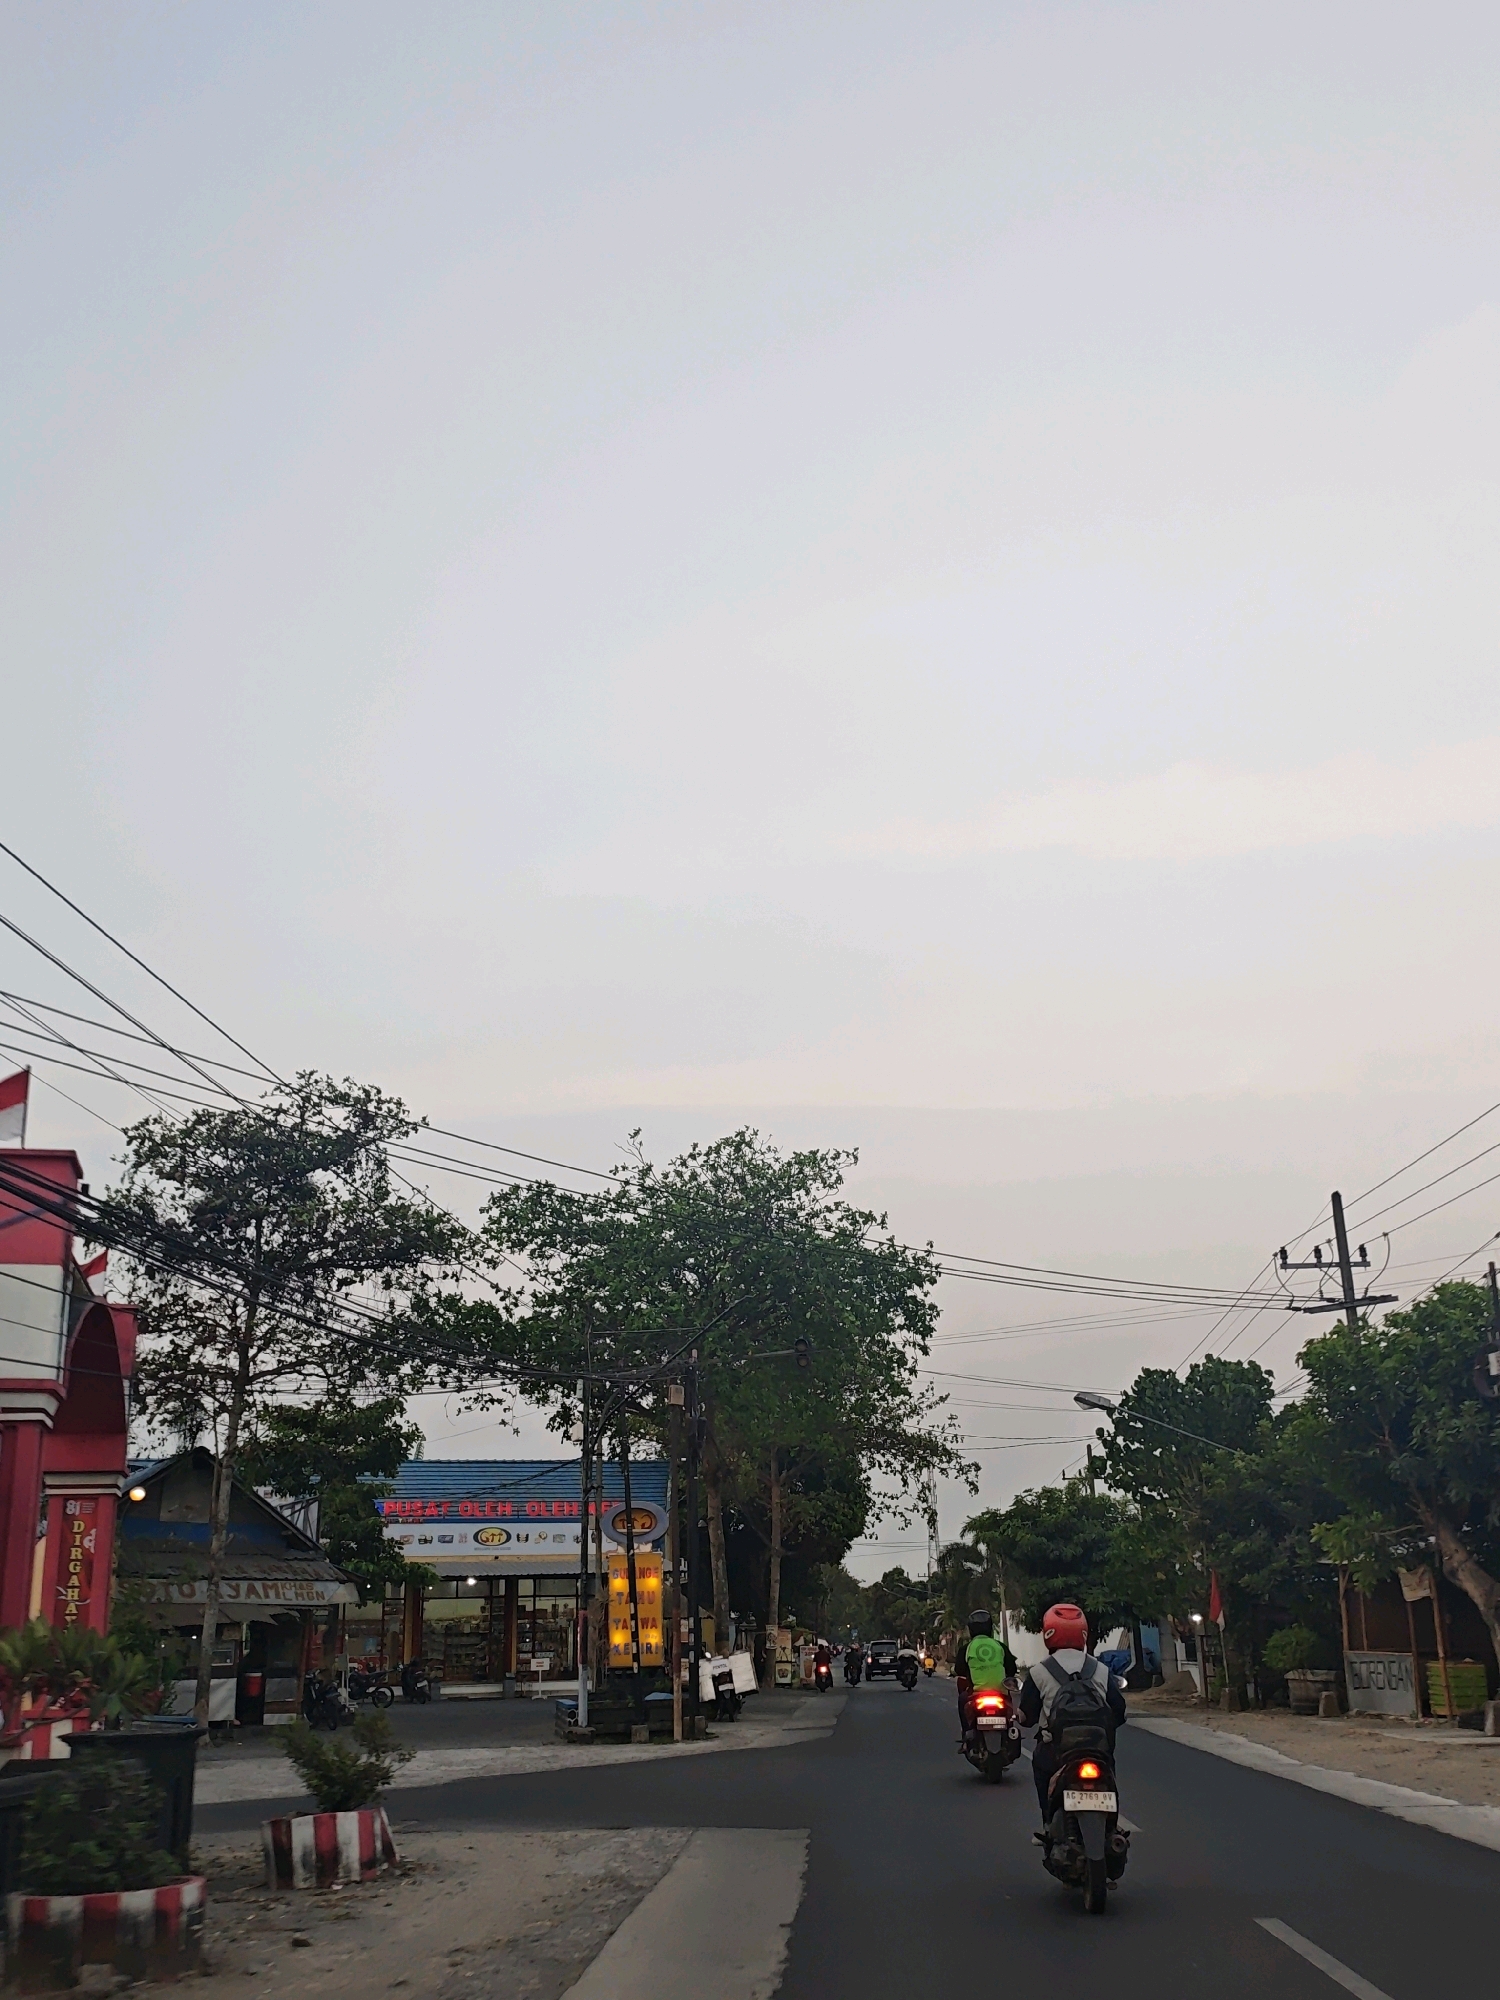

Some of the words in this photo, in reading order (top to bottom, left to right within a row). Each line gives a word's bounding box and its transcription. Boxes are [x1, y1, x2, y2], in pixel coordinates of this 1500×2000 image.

[384, 1500, 451, 1516] PUSAT
[458, 1500, 512, 1516] OLEH
[526, 1500, 578, 1516] OLEH
[64, 1520, 86, 1633] DIRGAHAY
[612, 1566, 659, 1580] GUNGE
[613, 1617, 658, 1630] TAWA
[612, 1642, 659, 1655] KEIRI
[1066, 1792, 1076, 1800] AG
[1079, 1792, 1099, 1801] 2769
